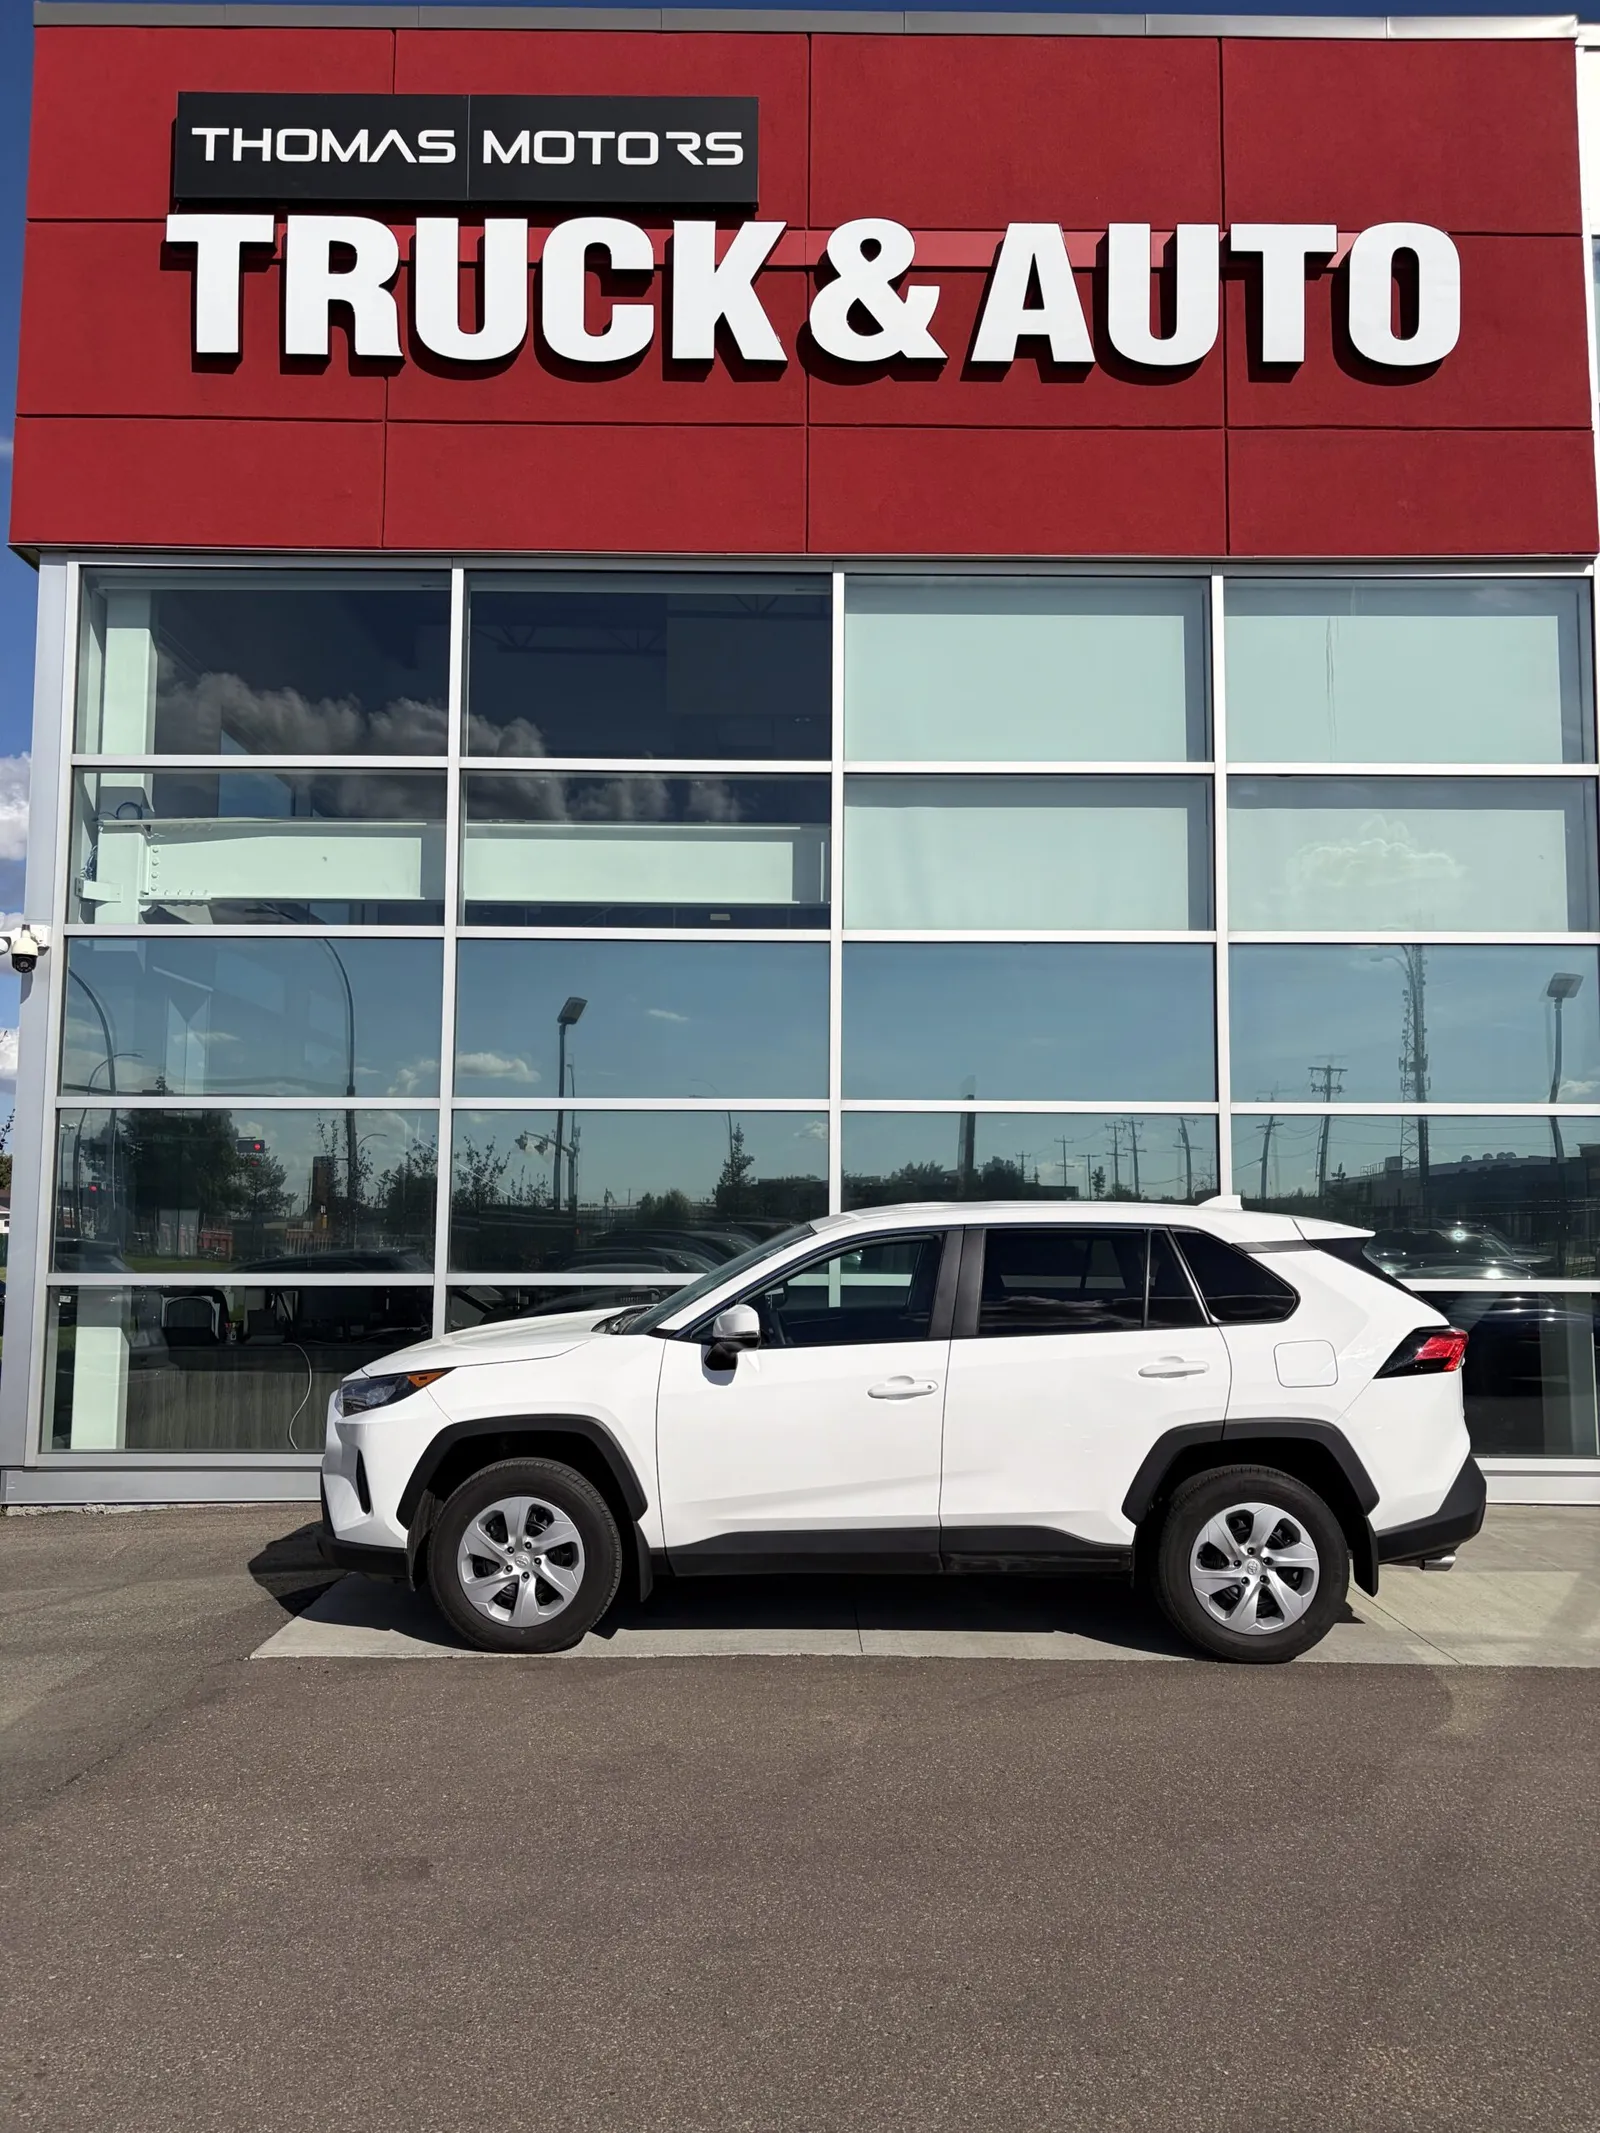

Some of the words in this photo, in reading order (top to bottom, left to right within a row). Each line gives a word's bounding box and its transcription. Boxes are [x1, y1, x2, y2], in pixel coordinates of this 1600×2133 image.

[191, 127, 456, 164] THOMAS
[482, 130, 744, 166] MOTORS
[165, 213, 788, 362] TRUCK
[809, 217, 948, 363] &
[971, 222, 1461, 366] AUTO
